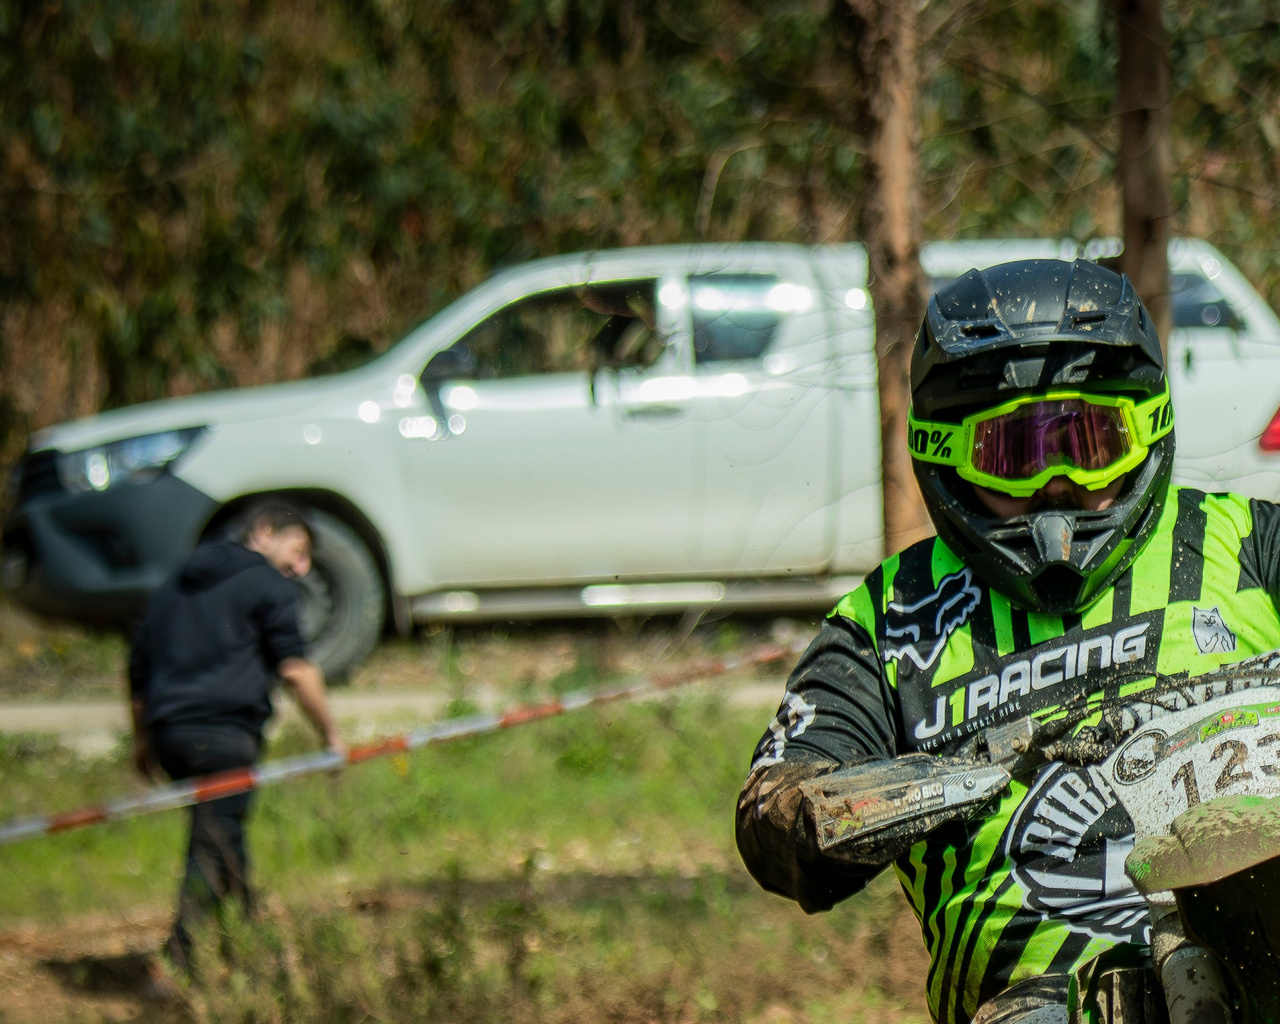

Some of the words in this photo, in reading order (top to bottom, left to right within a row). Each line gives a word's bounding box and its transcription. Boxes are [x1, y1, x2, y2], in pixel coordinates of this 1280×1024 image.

[941, 732, 952, 743] IS
[956, 728, 963, 737] A
[966, 712, 997, 733] CRAZY
[999, 701, 1021, 718] RIDE
[922, 782, 944, 799] BICO
